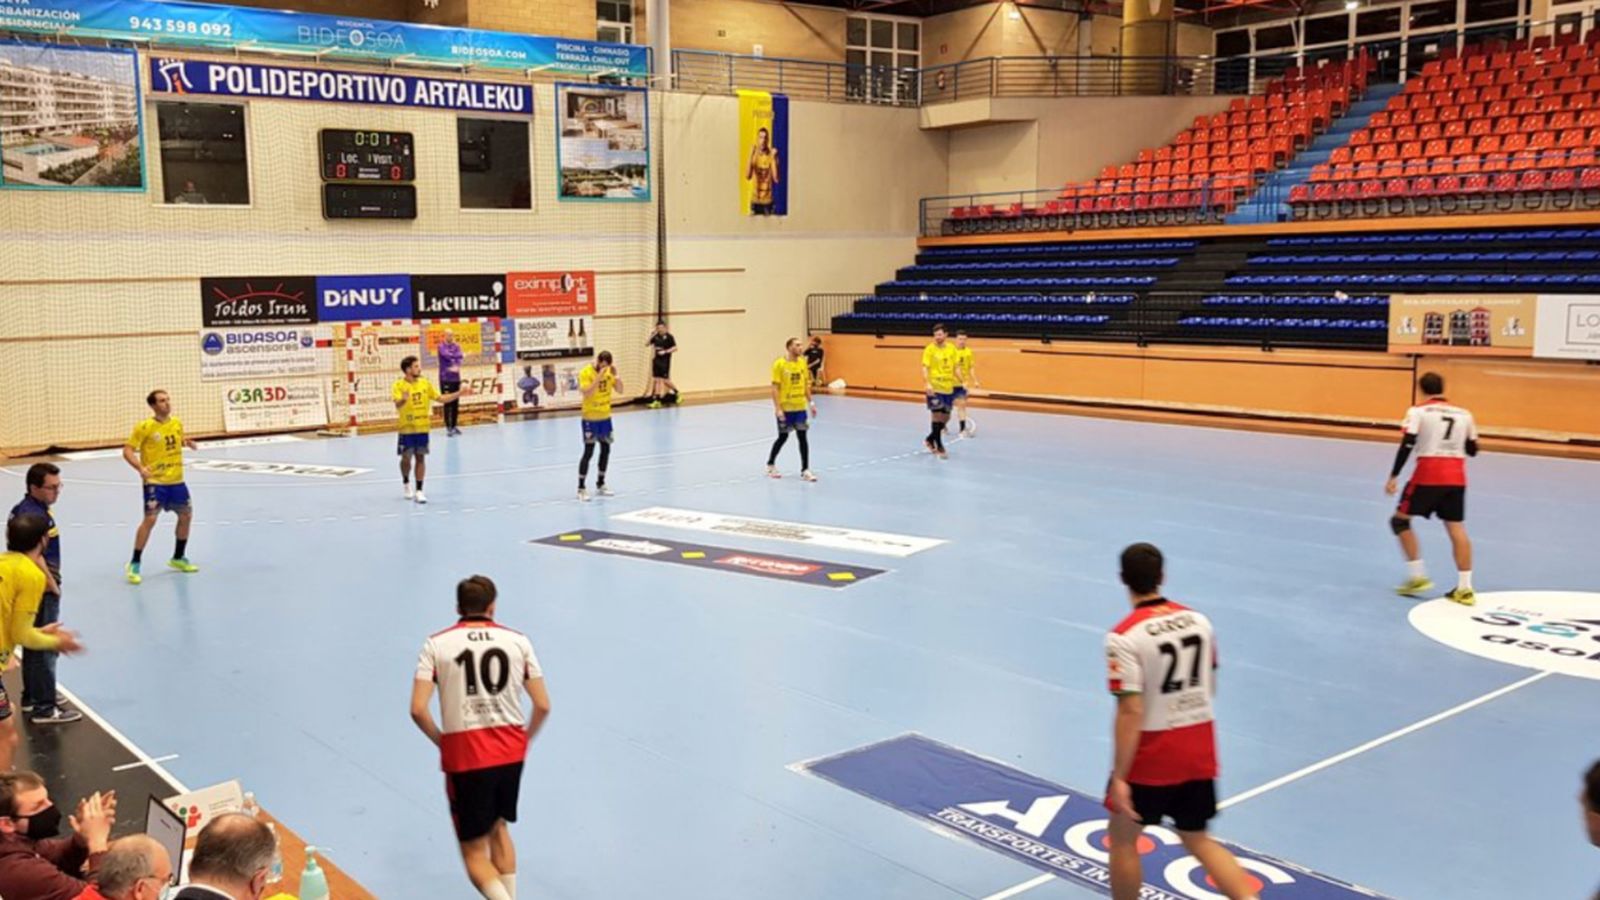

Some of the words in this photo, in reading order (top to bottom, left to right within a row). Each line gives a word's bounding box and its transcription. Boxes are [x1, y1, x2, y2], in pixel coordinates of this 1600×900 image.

[129, 16, 162, 31] 943
[166, 19, 197, 34] 598
[200, 22, 232, 37] 092
[297, 25, 406, 49] BIDEOSOA
[451, 45, 527, 59] BIDEOSOA.COM
[556, 52, 590, 62] TERRAZA
[208, 65, 406, 104] POLIDEPORTIVO
[413, 80, 524, 111] ARTALEKU
[336, 163, 346, 178] 0
[391, 166, 401, 180] 0
[214, 300, 262, 316] Toldos
[268, 298, 308, 316] Irun
[418, 289, 500, 312] Lacunza
[226, 331, 298, 344] BIDASOA
[226, 343, 299, 354] ascensores
[1441, 416, 1456, 440] 7
[467, 631, 494, 641] GIL
[454, 647, 510, 696] 10
[1158, 634, 1203, 694] 27
[936, 807, 1085, 870] TRANSPORTES
